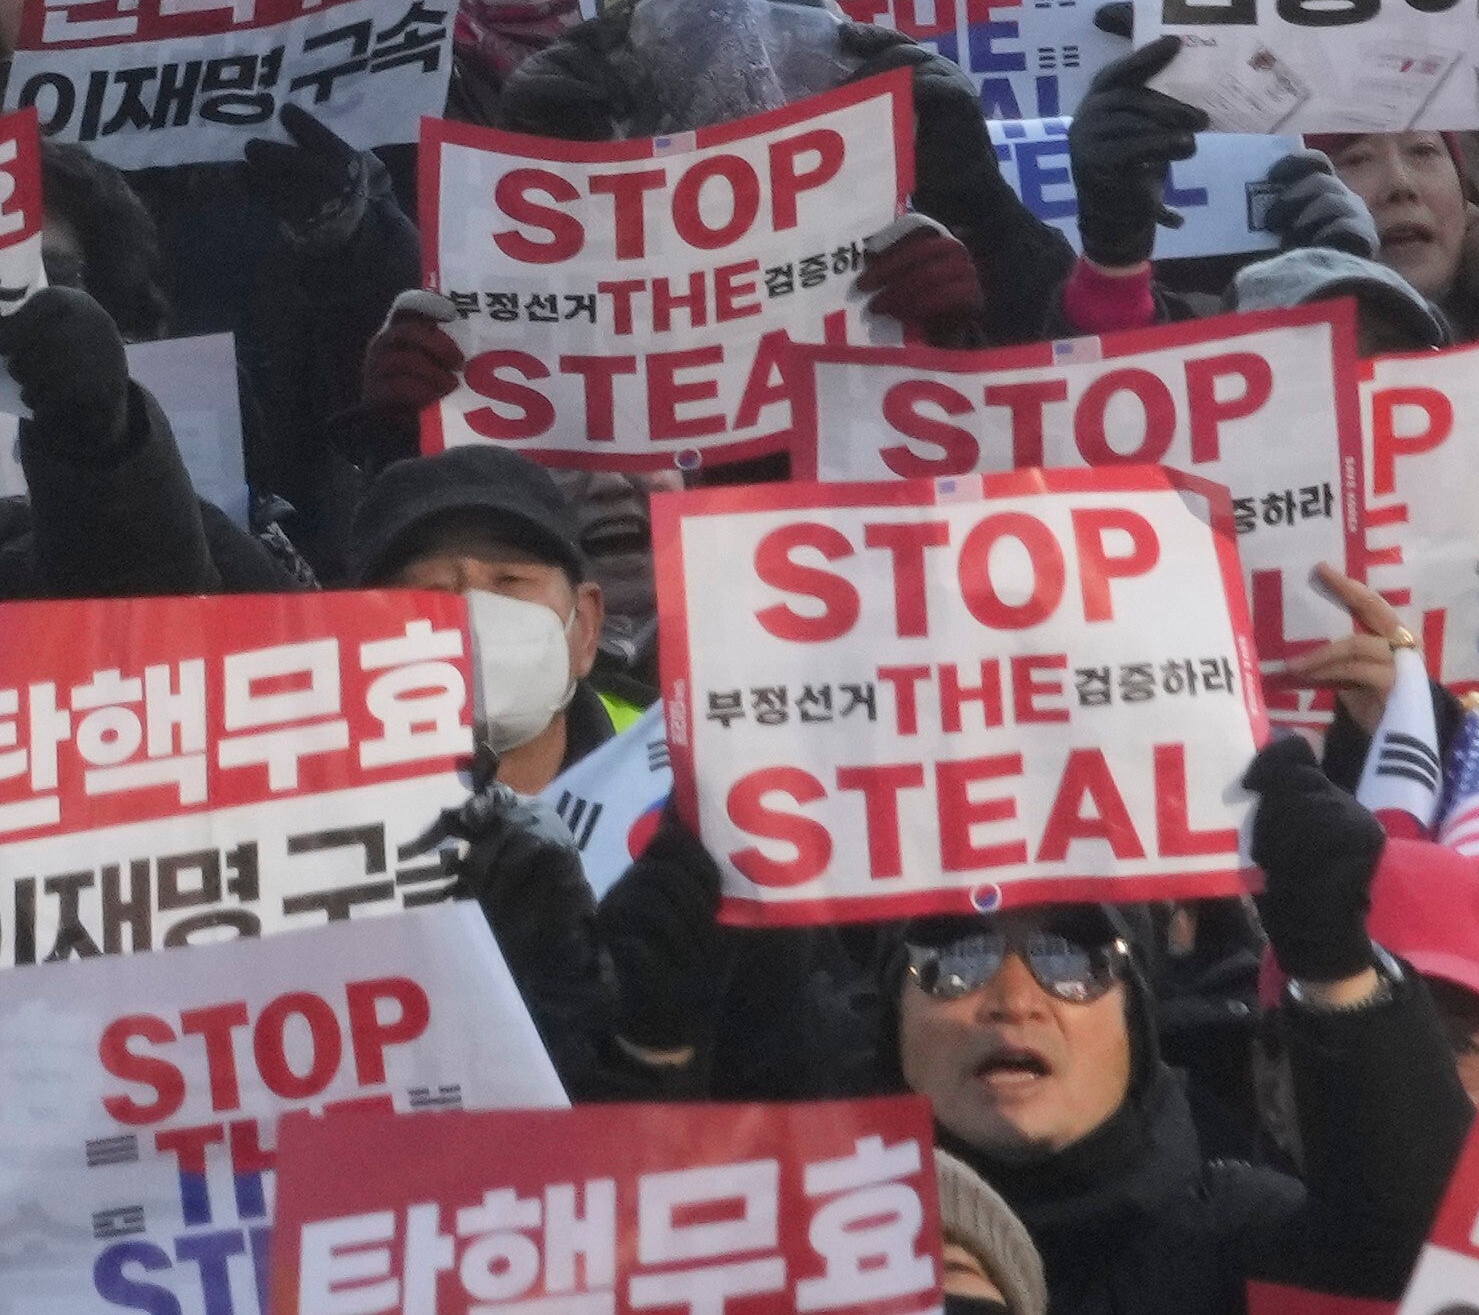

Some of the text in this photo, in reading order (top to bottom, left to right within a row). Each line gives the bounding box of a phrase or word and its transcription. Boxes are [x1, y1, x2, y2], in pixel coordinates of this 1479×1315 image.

[494, 128, 845, 262] STOP
[601, 260, 762, 335] THE
[754, 508, 1161, 645] STOP
[705, 681, 879, 730] 부정선거
[877, 654, 1071, 736] THE
[1075, 658, 1235, 709] 검증하라
[726, 741, 1240, 888] STEAL
[97, 976, 432, 1126] STOP
